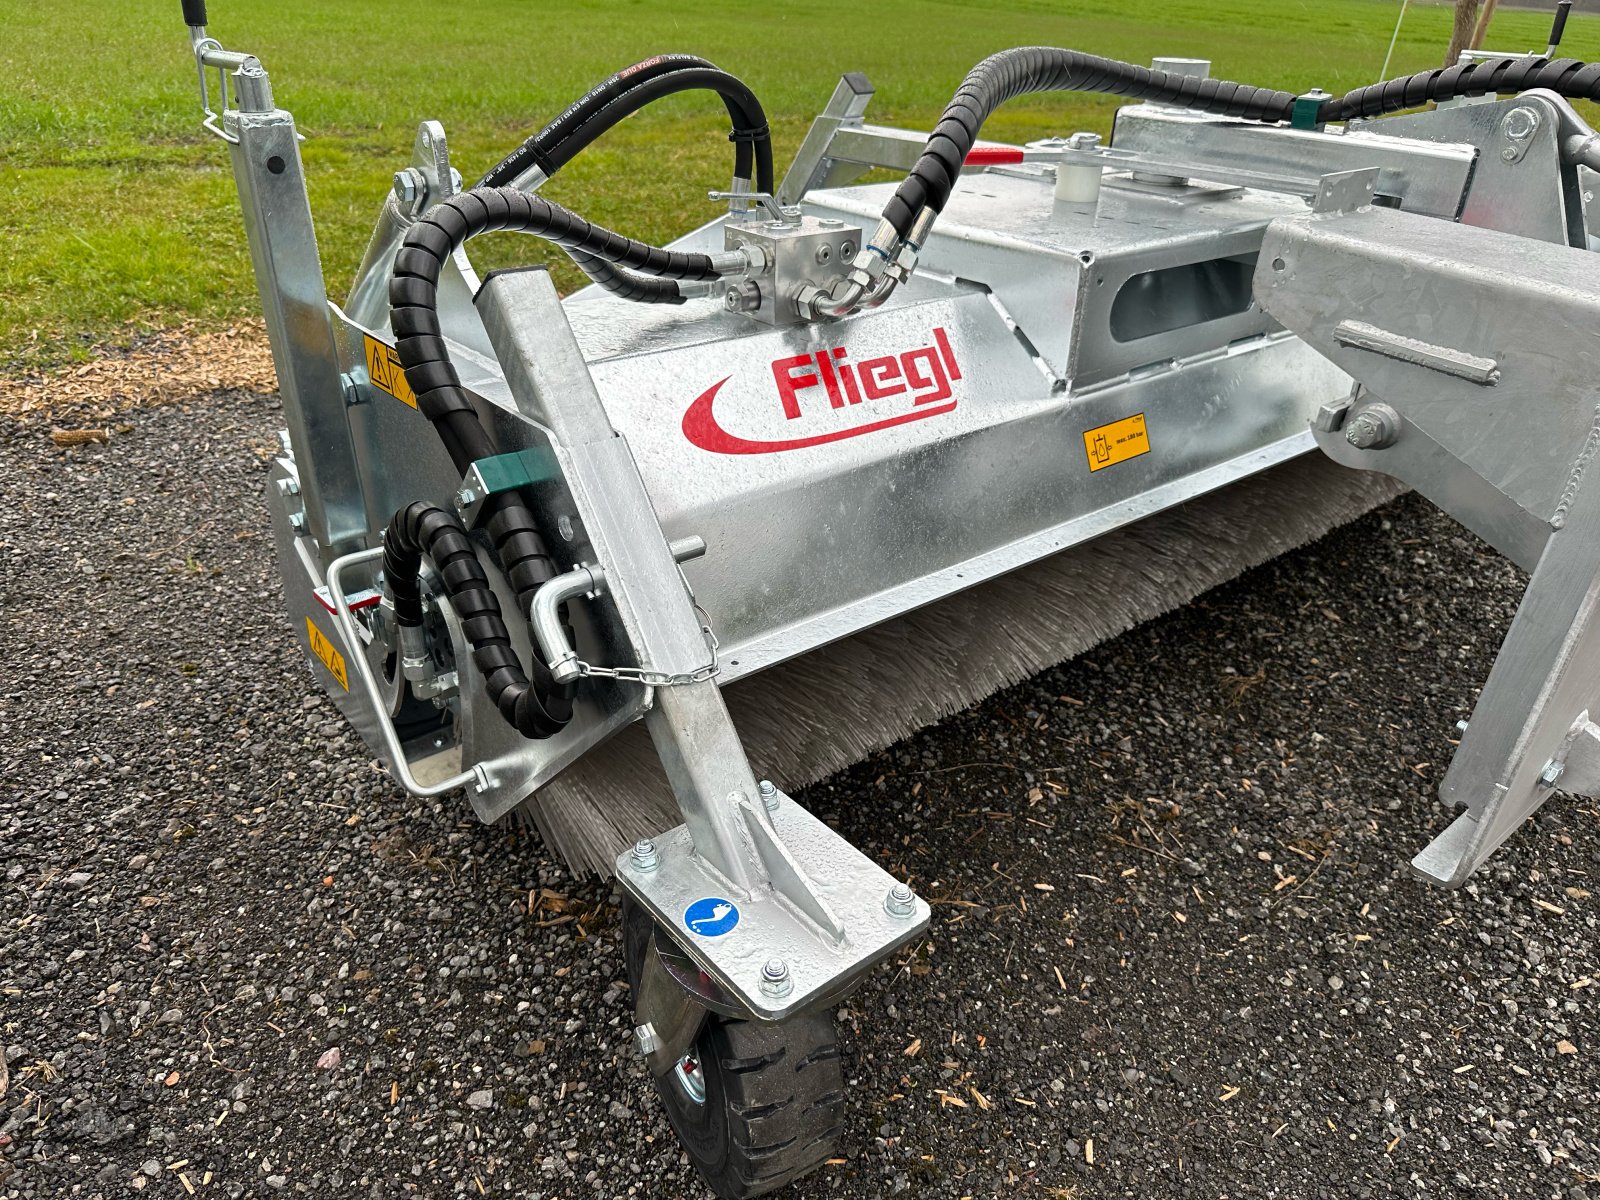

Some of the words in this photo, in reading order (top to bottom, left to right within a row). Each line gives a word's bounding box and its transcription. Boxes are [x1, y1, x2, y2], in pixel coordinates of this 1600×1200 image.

[638, 56, 660, 70] FORZA
[622, 67, 637, 78] DUE
[580, 96, 590, 106] DIN
[572, 103, 581, 112] EN
[551, 119, 562, 130] SAE
[772, 328, 962, 419] Fliegl
